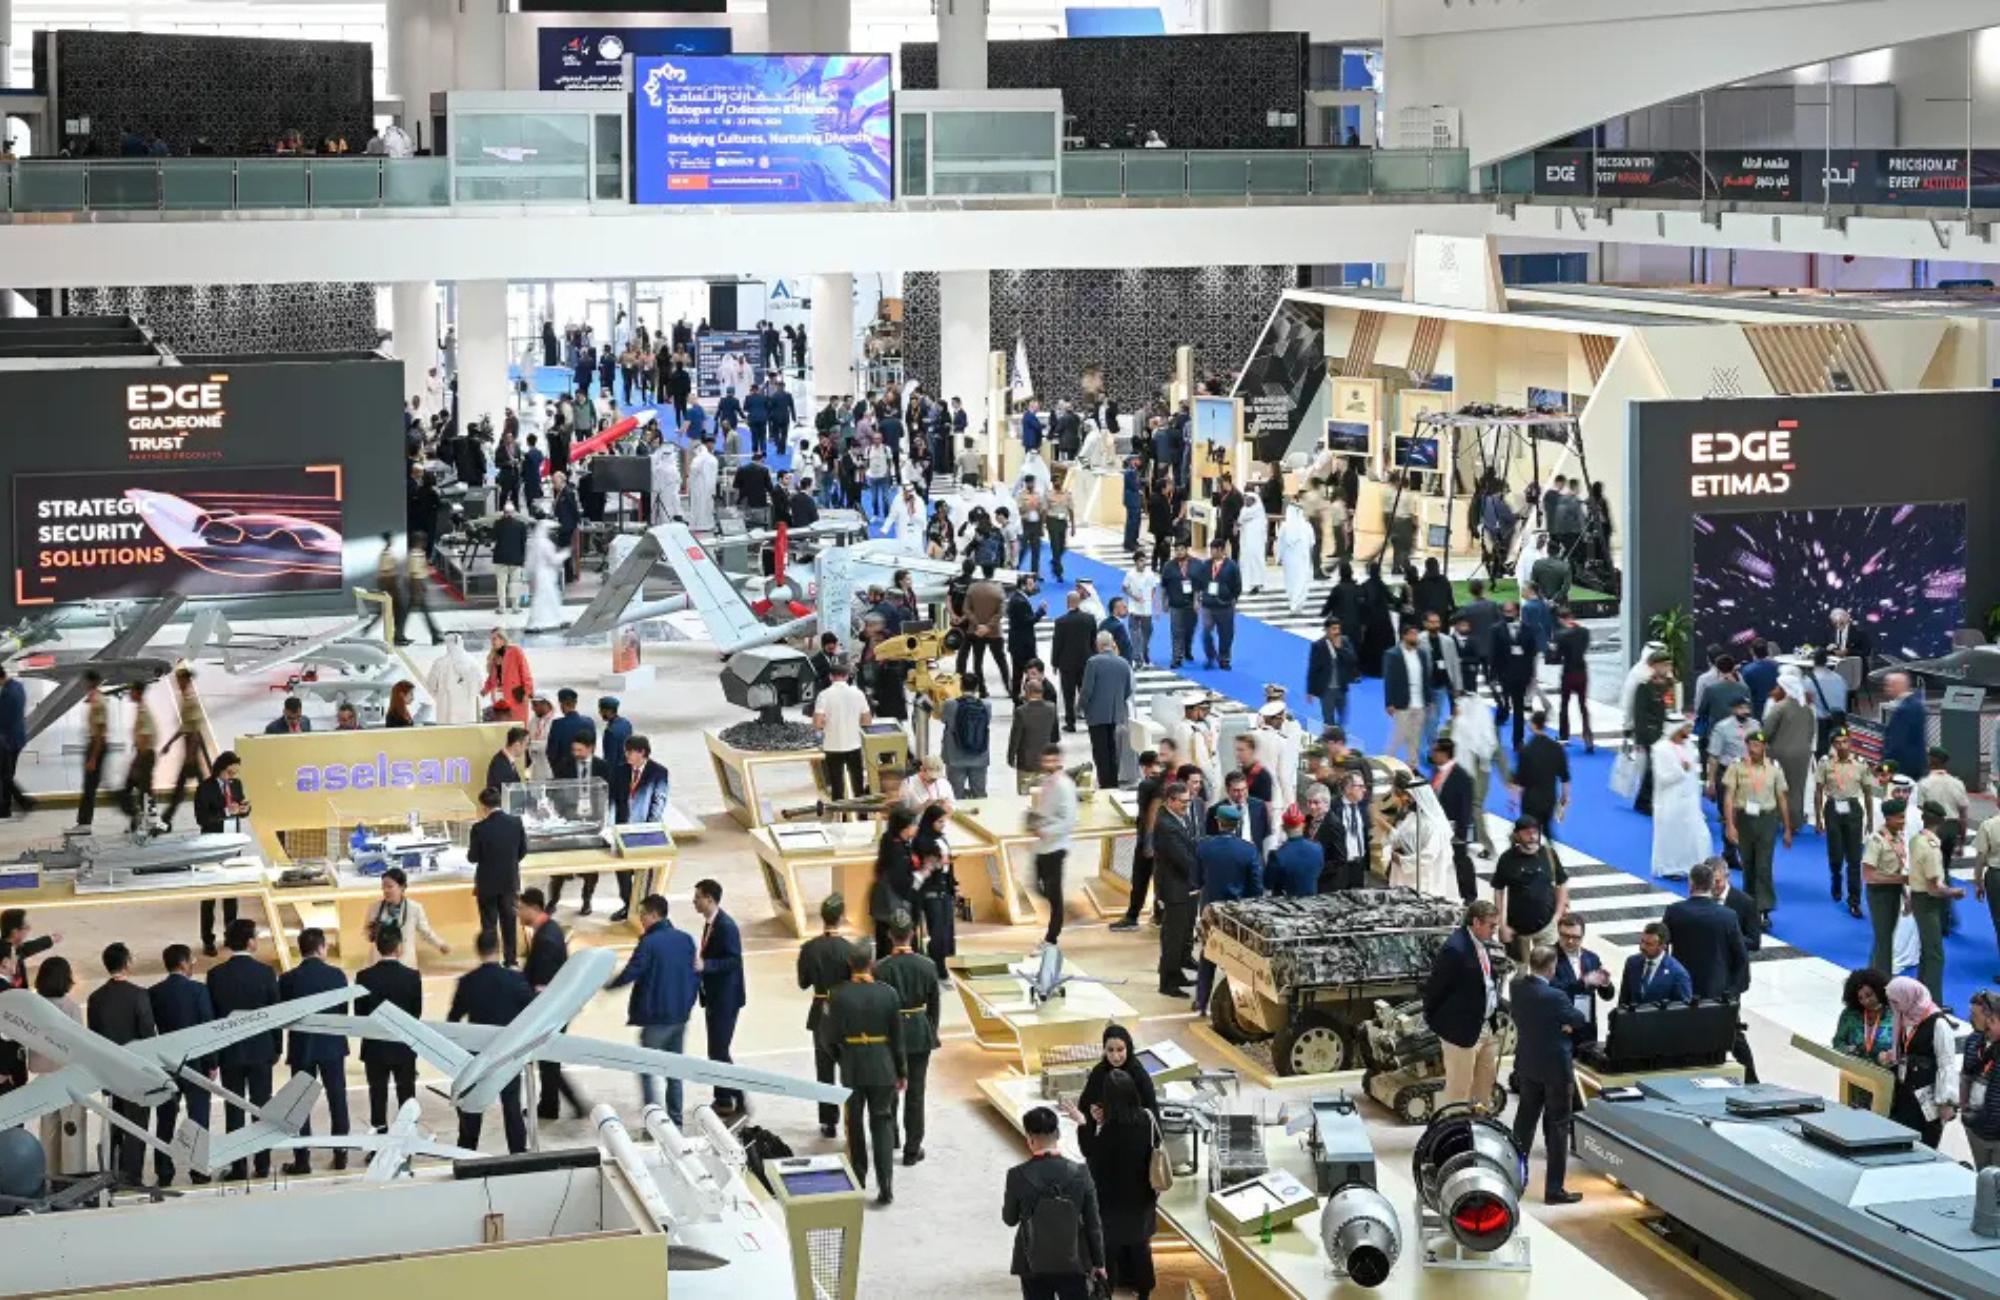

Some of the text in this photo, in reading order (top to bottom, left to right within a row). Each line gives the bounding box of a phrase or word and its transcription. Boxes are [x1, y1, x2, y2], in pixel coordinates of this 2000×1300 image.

[667, 104, 711, 116] Dialogue
[713, 104, 725, 113] of
[667, 132, 715, 149] Bridging
[718, 132, 767, 145] Cultures,
[769, 132, 822, 146] Nurturing
[1546, 166, 1576, 182] EDGE
[1888, 158, 1959, 172] PRECISION AT
[1888, 176, 1921, 189] EVERY
[127, 384, 222, 411] EDGE
[128, 414, 222, 431] GRADEONE
[129, 436, 184, 451] TRUST
[1691, 430, 1791, 464] EDGE
[1691, 472, 1791, 498] ETIMAD
[38, 497, 157, 519] STRATEGIC
[38, 522, 145, 543] SECURITY
[39, 546, 166, 568] SOLUTIONS
[296, 751, 471, 792] aselsan
